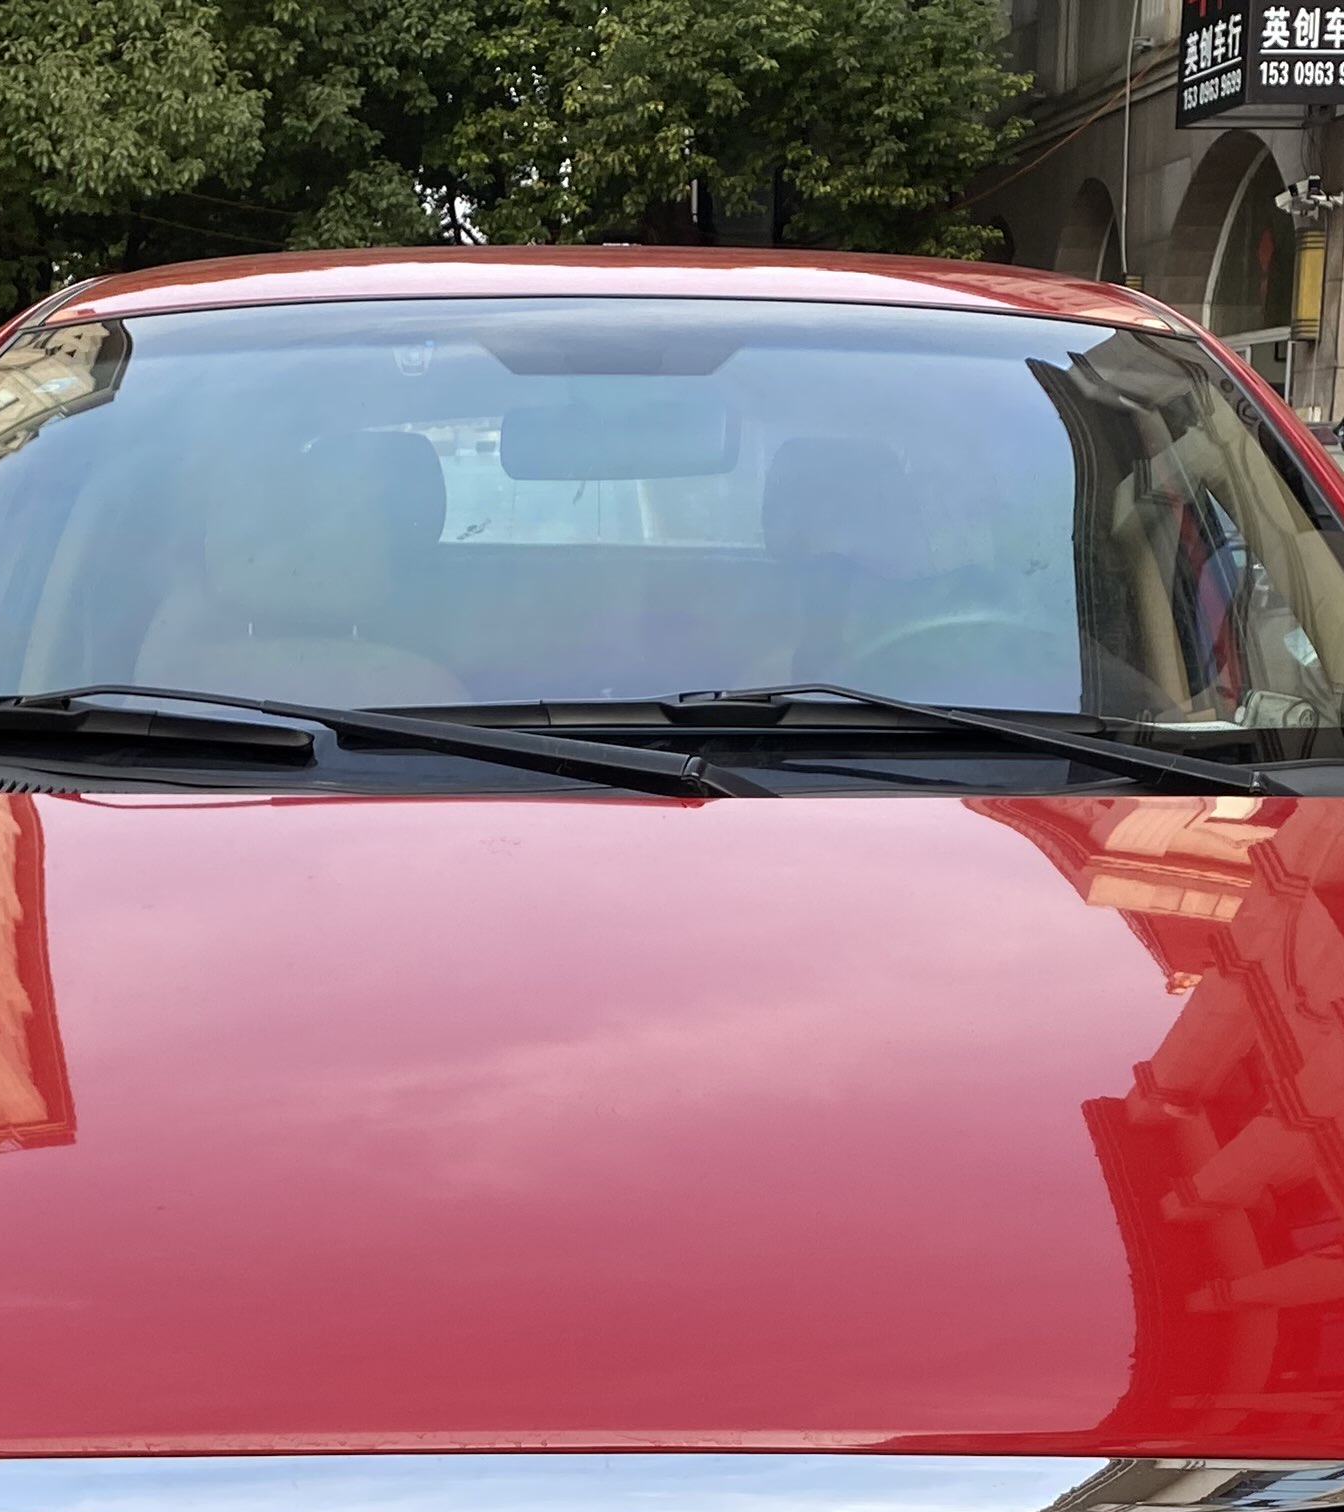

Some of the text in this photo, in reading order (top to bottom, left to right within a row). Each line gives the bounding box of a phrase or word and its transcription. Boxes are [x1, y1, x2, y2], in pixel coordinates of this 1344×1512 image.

[1184, 13, 1242, 75] 英创车行
[1259, 61, 1289, 85] 153
[1294, 61, 1334, 85] 0963
[1183, 85, 1198, 110] 153
